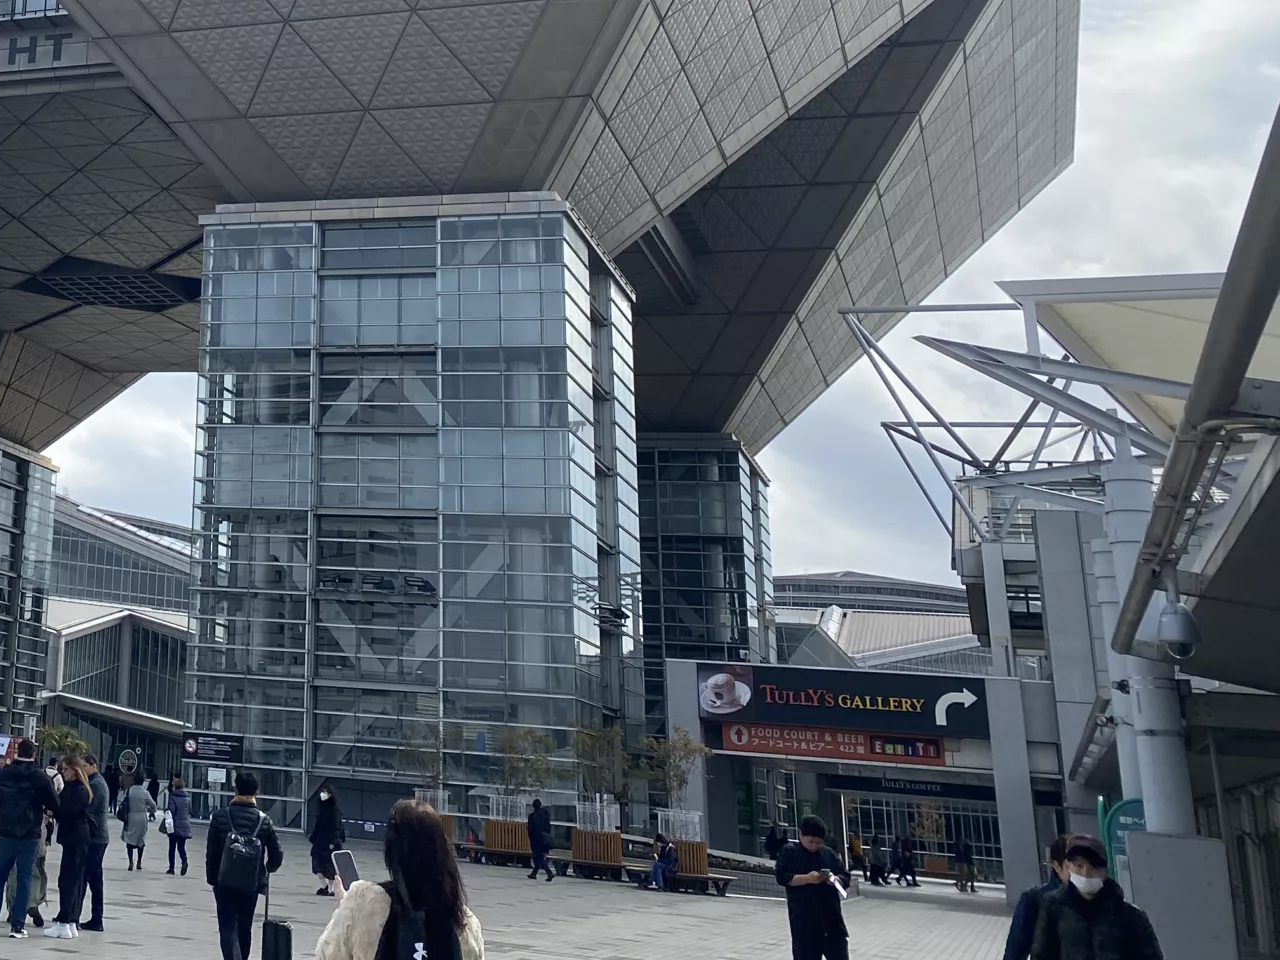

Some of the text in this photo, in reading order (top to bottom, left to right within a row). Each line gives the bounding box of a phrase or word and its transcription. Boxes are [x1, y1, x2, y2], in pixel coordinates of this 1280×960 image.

[838, 694, 925, 713] GALLERY
[751, 727, 865, 744] FOOD COURT & BEER
